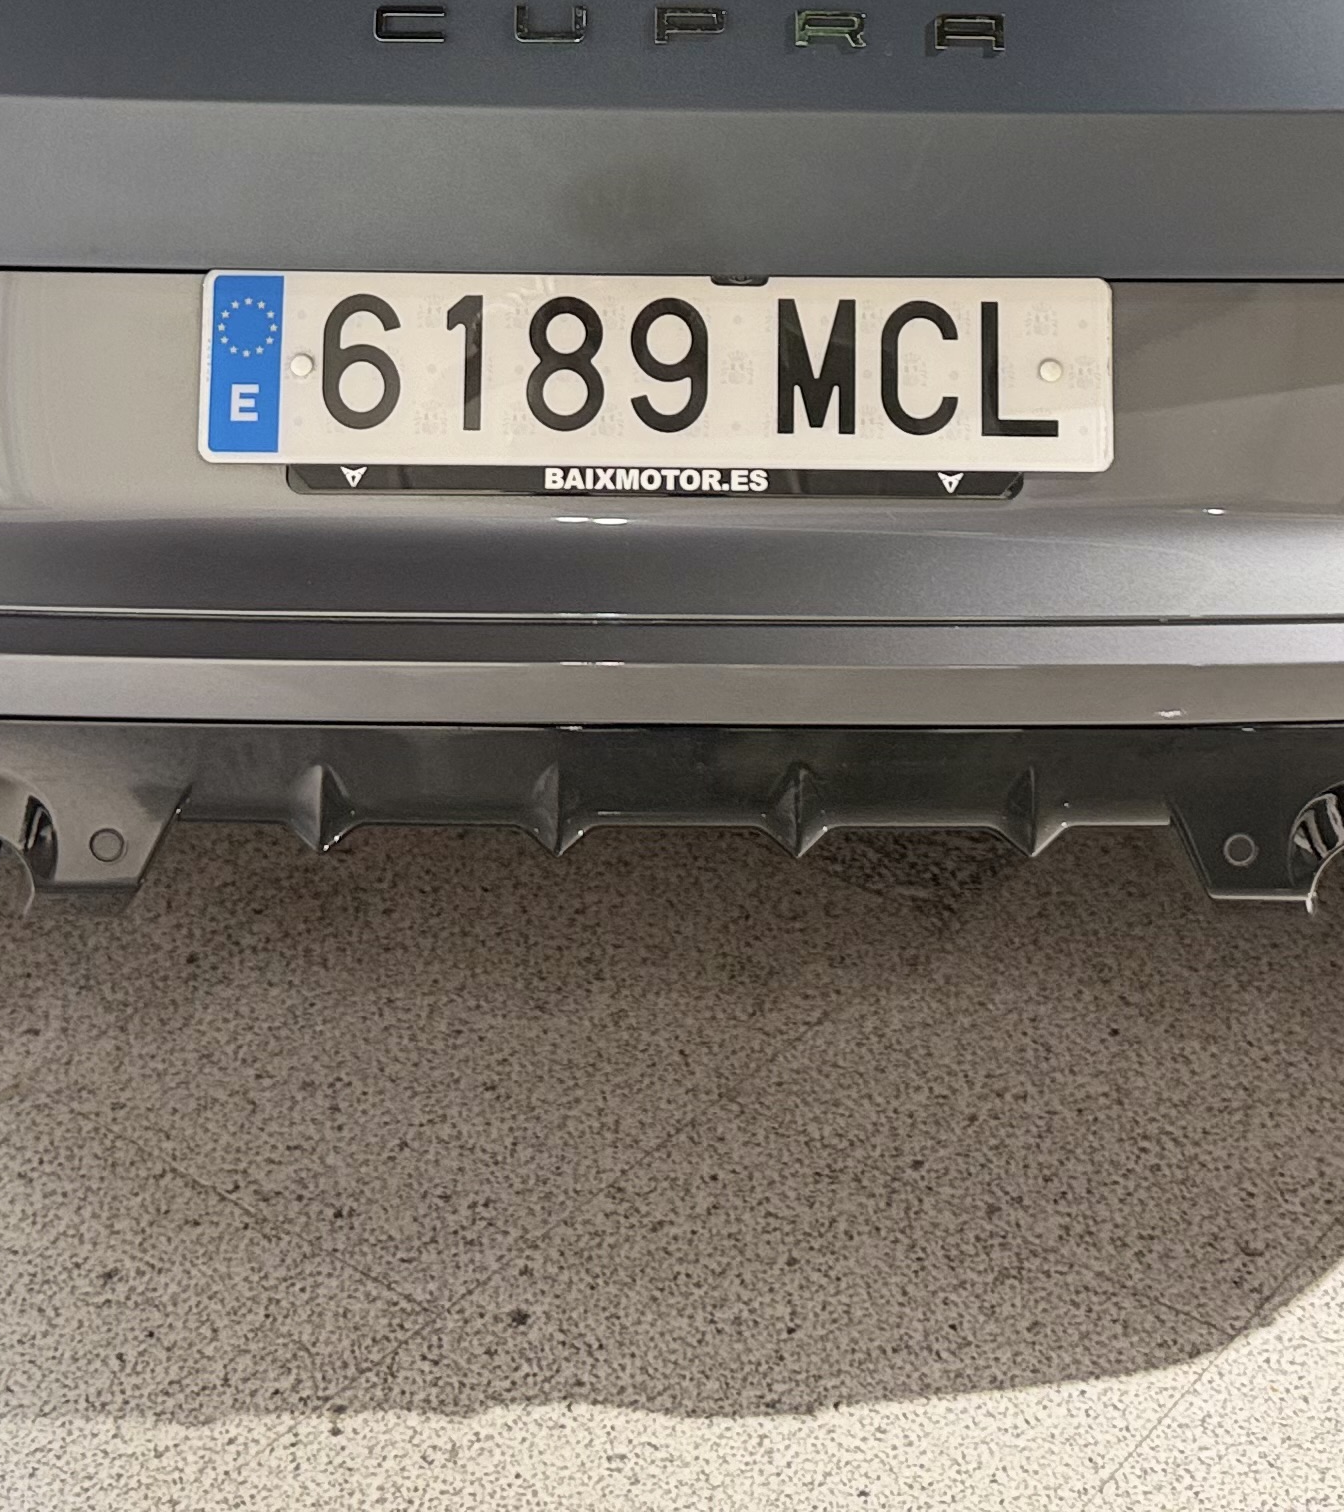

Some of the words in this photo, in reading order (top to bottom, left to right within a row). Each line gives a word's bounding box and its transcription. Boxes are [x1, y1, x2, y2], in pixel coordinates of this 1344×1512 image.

[373, 5, 1005, 52] CUPRA
[322, 293, 708, 434] 6189
[777, 298, 1059, 437] MCL
[230, 383, 260, 422] E
[544, 467, 769, 492] BAIXMOTOR.ES
